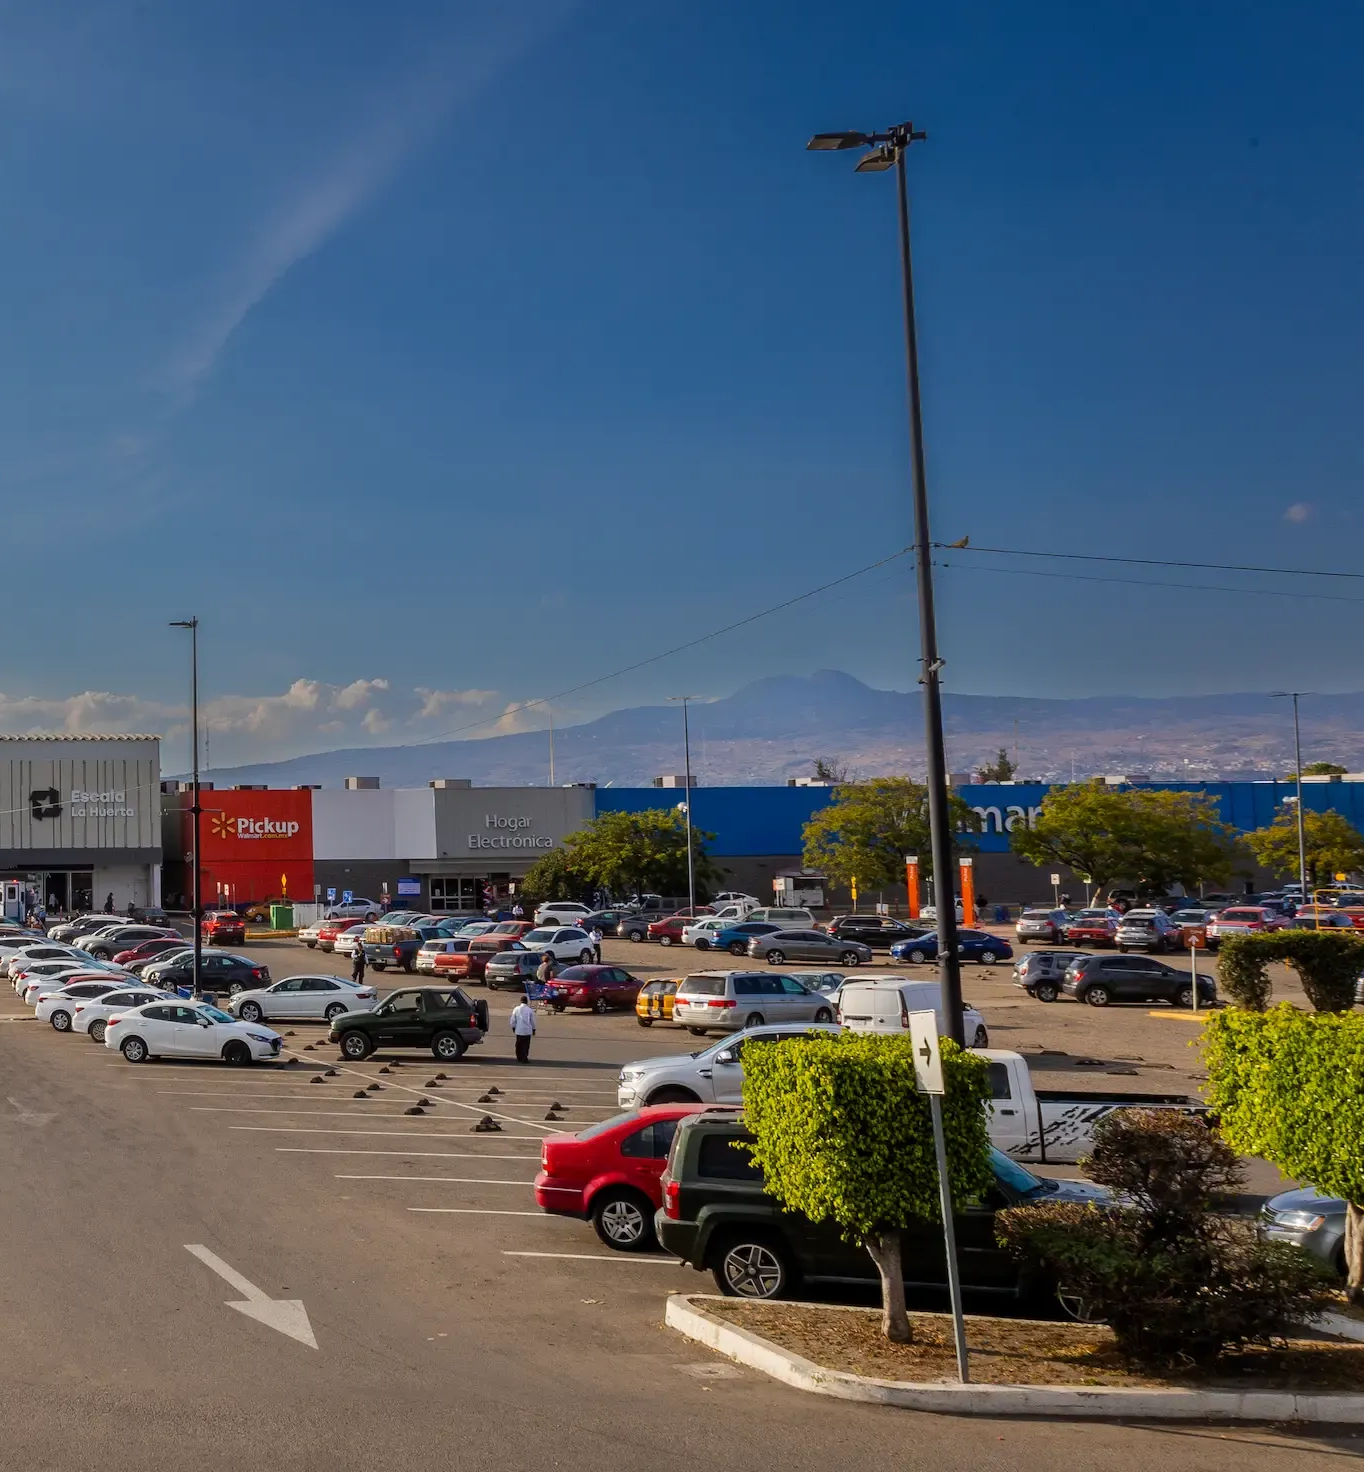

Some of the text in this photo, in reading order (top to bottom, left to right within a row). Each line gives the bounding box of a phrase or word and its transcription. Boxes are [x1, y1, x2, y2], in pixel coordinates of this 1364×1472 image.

[71, 789, 125, 803] Escala
[71, 806, 134, 817] La Huerta
[237, 817, 300, 837] Pickup
[485, 814, 533, 832] Hogar
[468, 833, 553, 848] Electrónica
